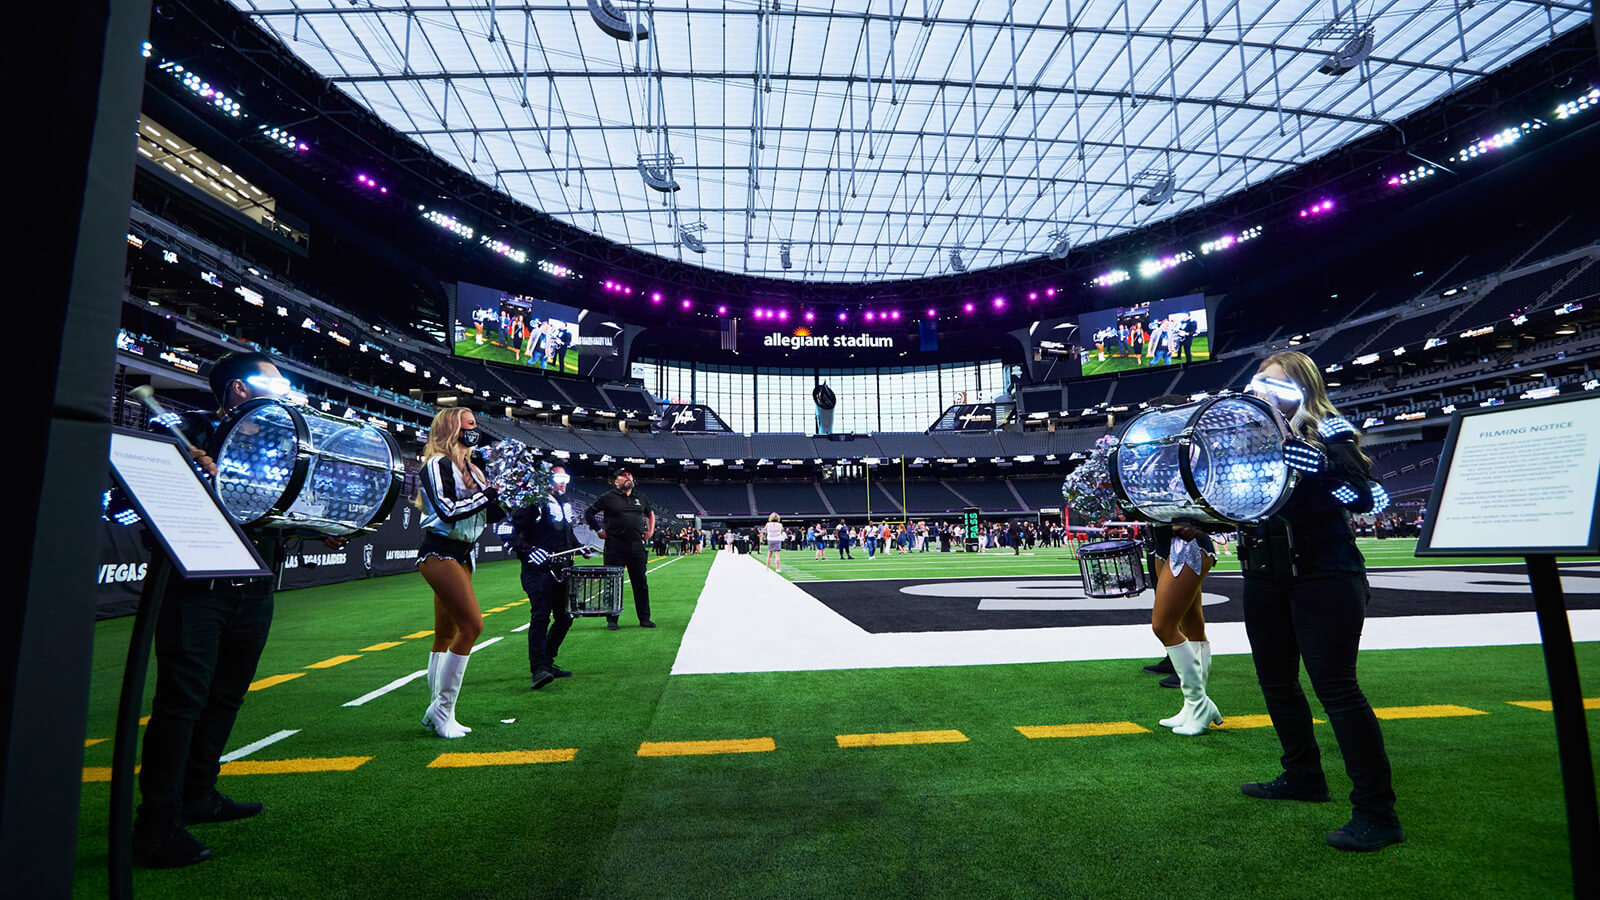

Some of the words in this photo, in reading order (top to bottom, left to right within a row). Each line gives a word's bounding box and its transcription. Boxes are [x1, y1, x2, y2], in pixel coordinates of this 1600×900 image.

[764, 332, 829, 349] allegiant
[833, 333, 893, 347] stadium
[1480, 427, 1527, 438] FILMING
[1530, 421, 1574, 432] NOTICE
[970, 512, 978, 538] PASS
[284, 555, 299, 568] LAS
[322, 553, 347, 566] RAIDERS
[97, 562, 148, 584] VEGAS
